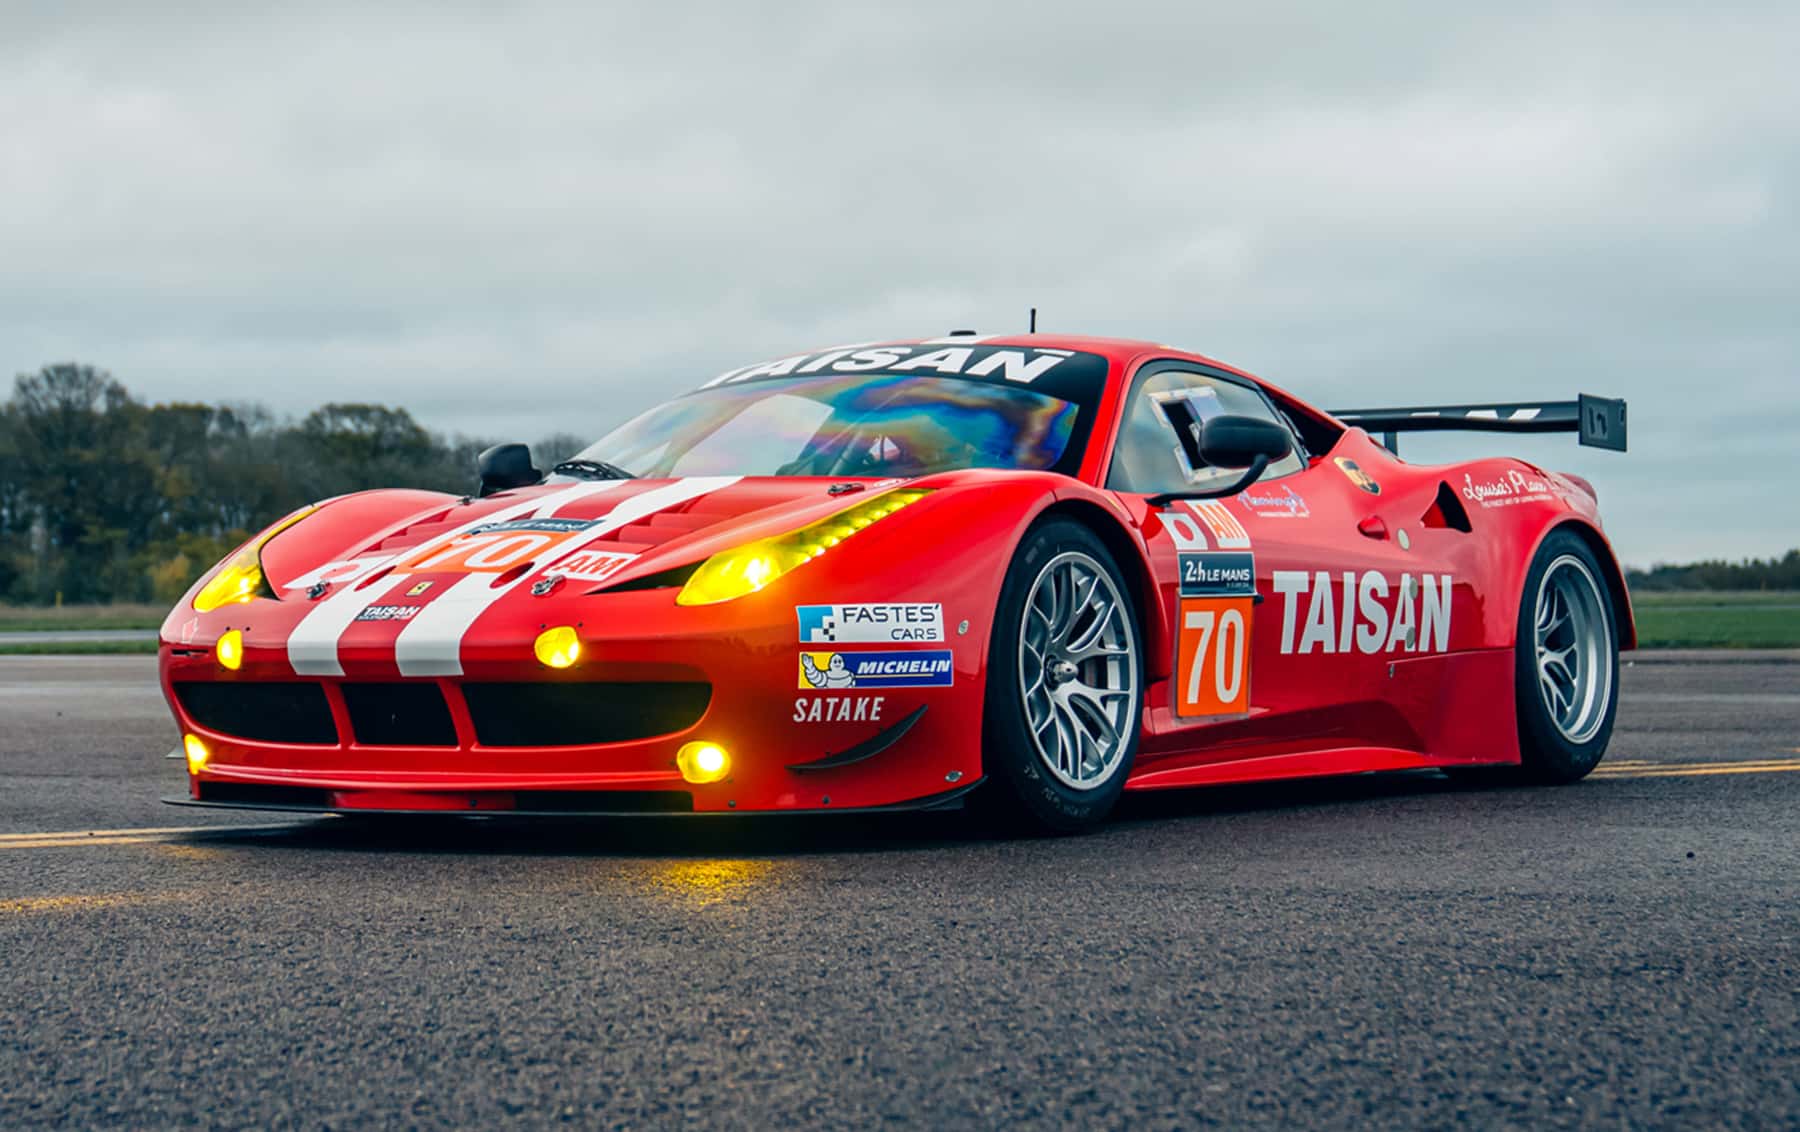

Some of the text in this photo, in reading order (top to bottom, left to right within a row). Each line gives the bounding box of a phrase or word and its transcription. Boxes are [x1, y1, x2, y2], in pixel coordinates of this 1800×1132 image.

[698, 346, 1068, 389] TAISAN
[408, 533, 552, 569] 70
[551, 554, 629, 576] AM
[1207, 569, 1220, 582] LE
[1221, 568, 1250, 581] MANS
[1272, 569, 1453, 655] TAISAN
[891, 628, 937, 641] CARS
[857, 659, 951, 674] MICHELIN
[1184, 608, 1245, 705] 70
[793, 696, 886, 723] SATAKE
